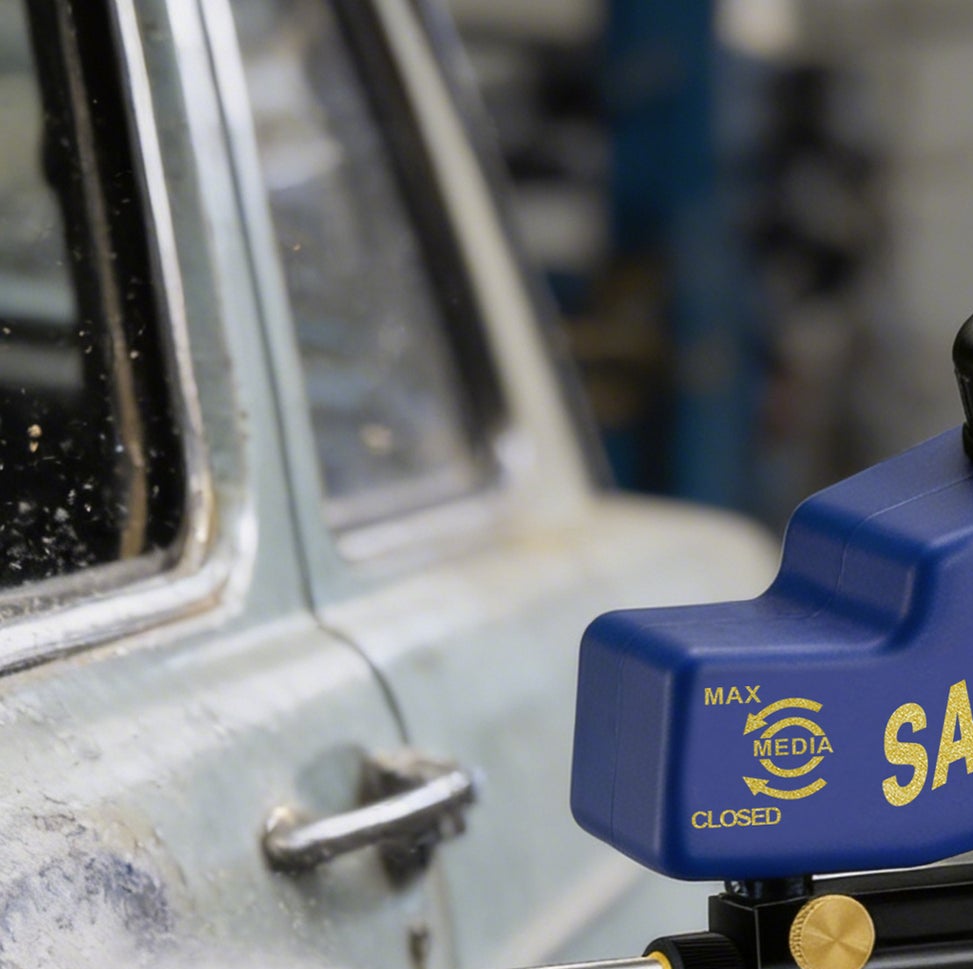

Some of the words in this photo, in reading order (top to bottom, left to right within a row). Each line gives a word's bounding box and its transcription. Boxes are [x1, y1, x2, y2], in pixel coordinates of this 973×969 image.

[704, 685, 761, 705] MAX
[753, 736, 834, 757] MEDIA
[691, 806, 782, 829] CLOSED
